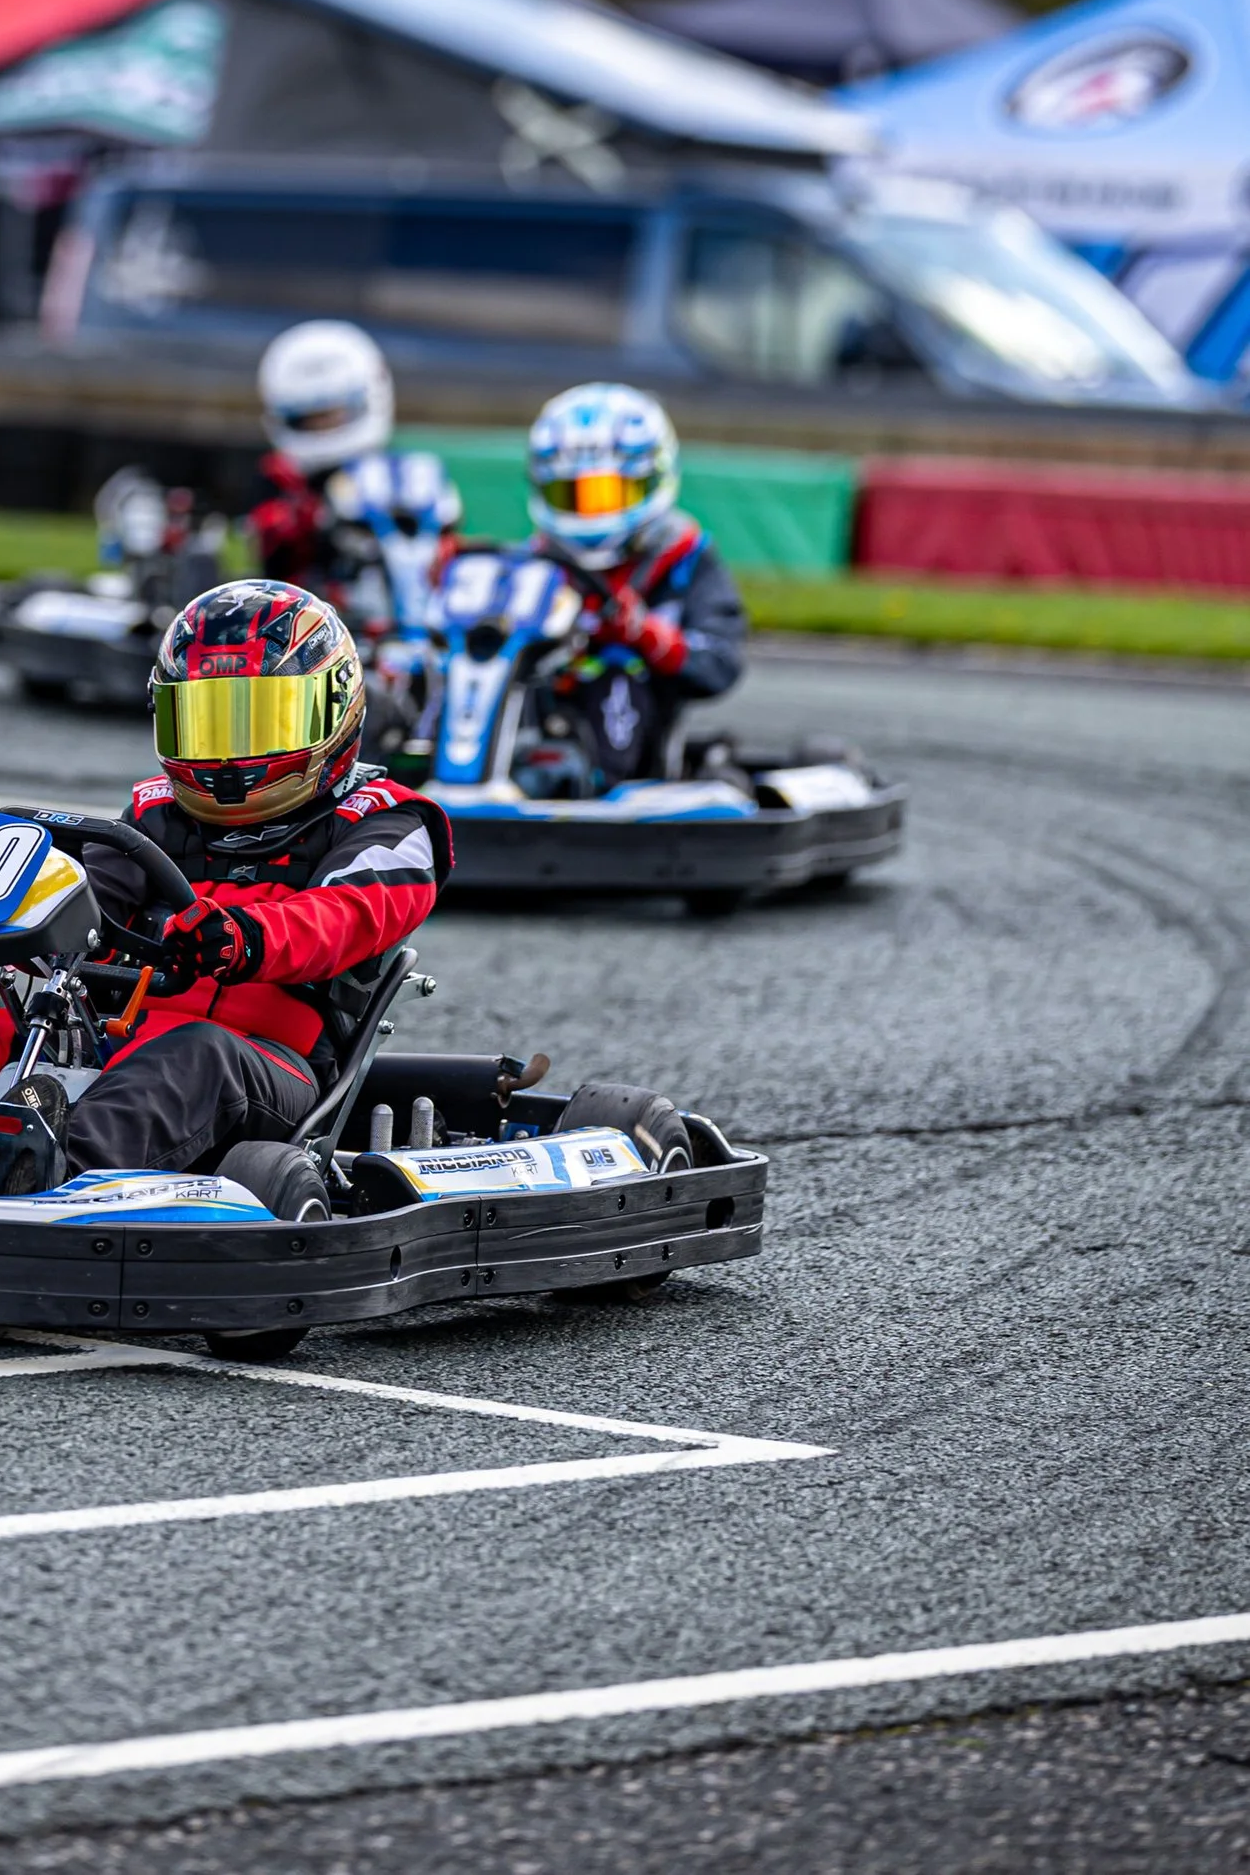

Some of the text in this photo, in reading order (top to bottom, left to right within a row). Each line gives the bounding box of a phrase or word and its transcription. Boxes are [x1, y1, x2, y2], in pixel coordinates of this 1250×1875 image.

[447, 554, 553, 622] 31
[200, 656, 247, 675] OMP
[33, 810, 85, 825] DRS
[25, 1087, 39, 1109] OMP
[412, 1147, 535, 1175] RICCIARDO
[580, 1148, 617, 1168] DRS
[175, 1189, 223, 1199] KART
